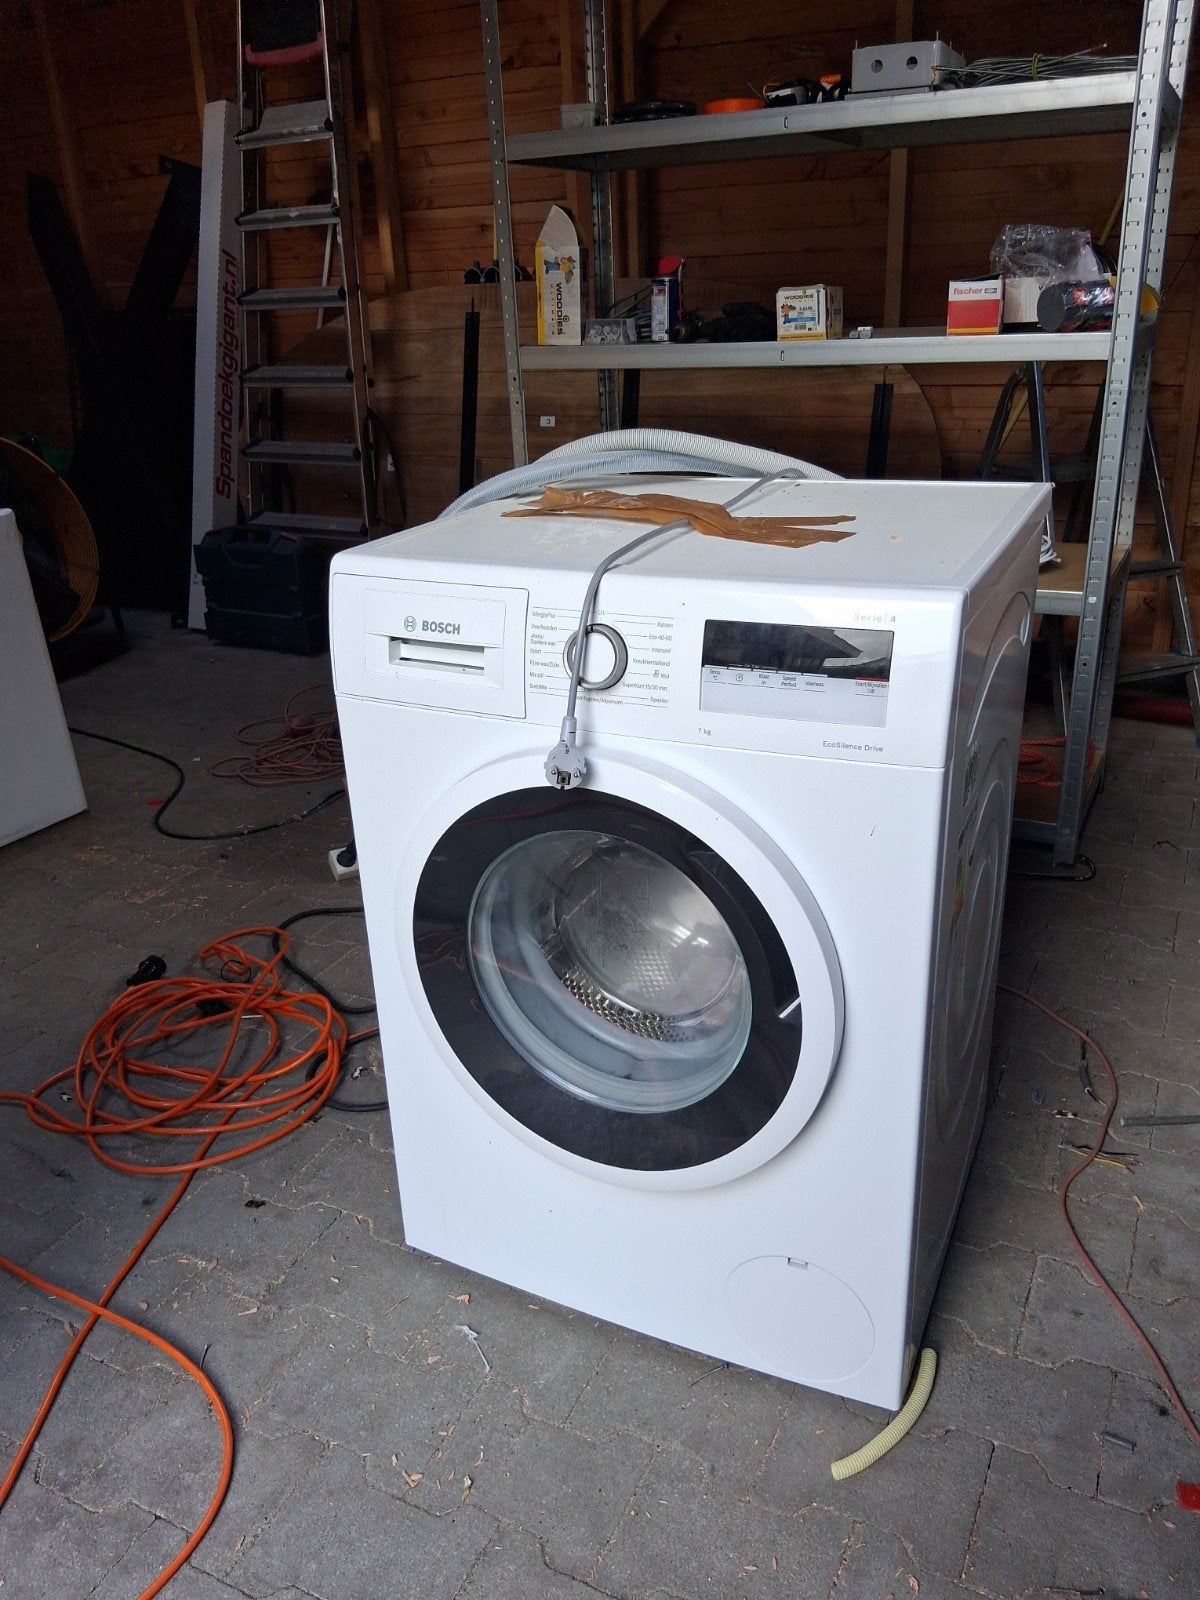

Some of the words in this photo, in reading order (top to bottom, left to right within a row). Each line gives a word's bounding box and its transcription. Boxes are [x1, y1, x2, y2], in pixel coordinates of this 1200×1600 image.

[953, 286, 984, 296] fischer
[556, 282, 566, 336] WOODIES
[214, 248, 239, 500] Spandoekgigant.nl
[854, 613, 883, 623] Serie
[889, 614, 896, 623] 4
[421, 619, 461, 635] BOSCH
[703, 728, 712, 736] kg
[822, 740, 863, 751] EcoSilence
[864, 744, 884, 753] Drive
